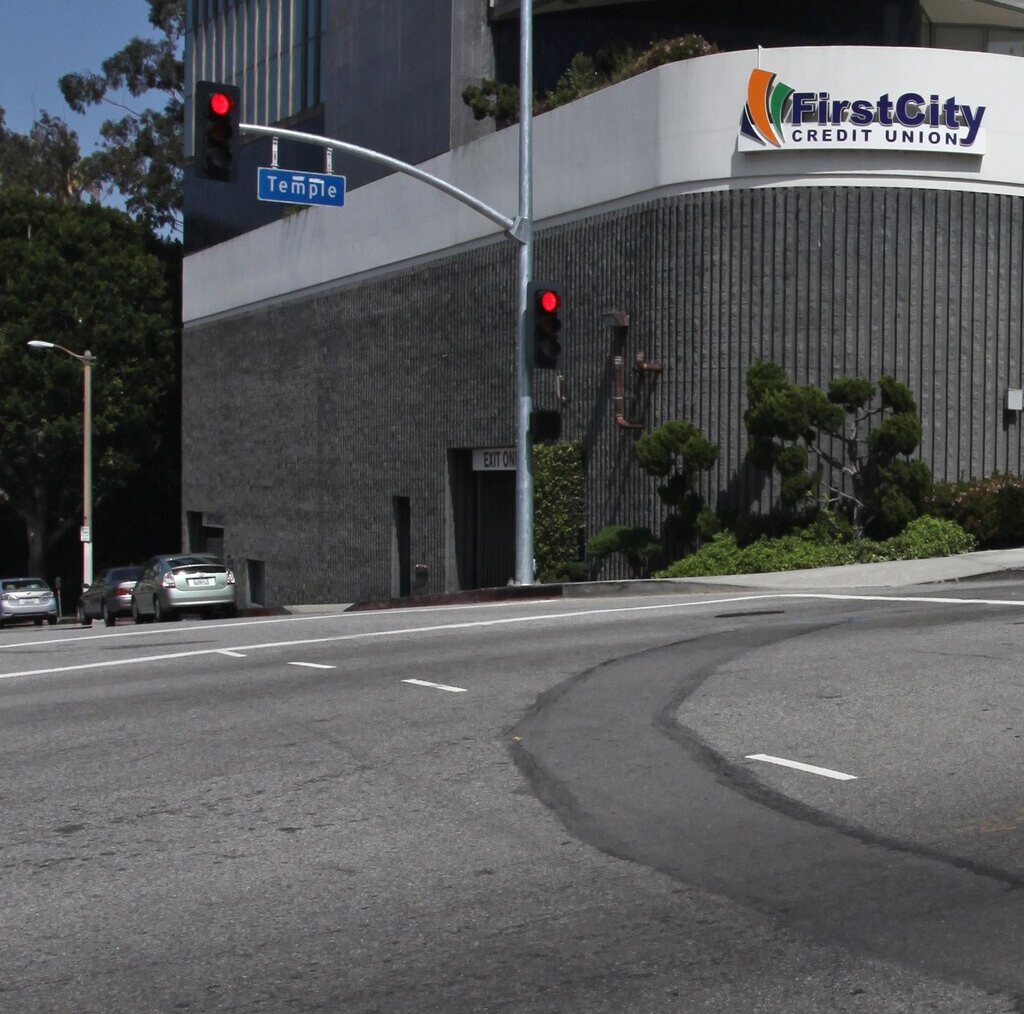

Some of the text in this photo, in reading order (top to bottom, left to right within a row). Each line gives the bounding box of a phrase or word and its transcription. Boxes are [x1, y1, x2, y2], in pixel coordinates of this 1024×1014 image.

[791, 92, 986, 146] FirstCity
[792, 129, 957, 145] CREDIT UNION
[267, 175, 337, 199] Temple
[483, 451, 501, 468] EXIT
